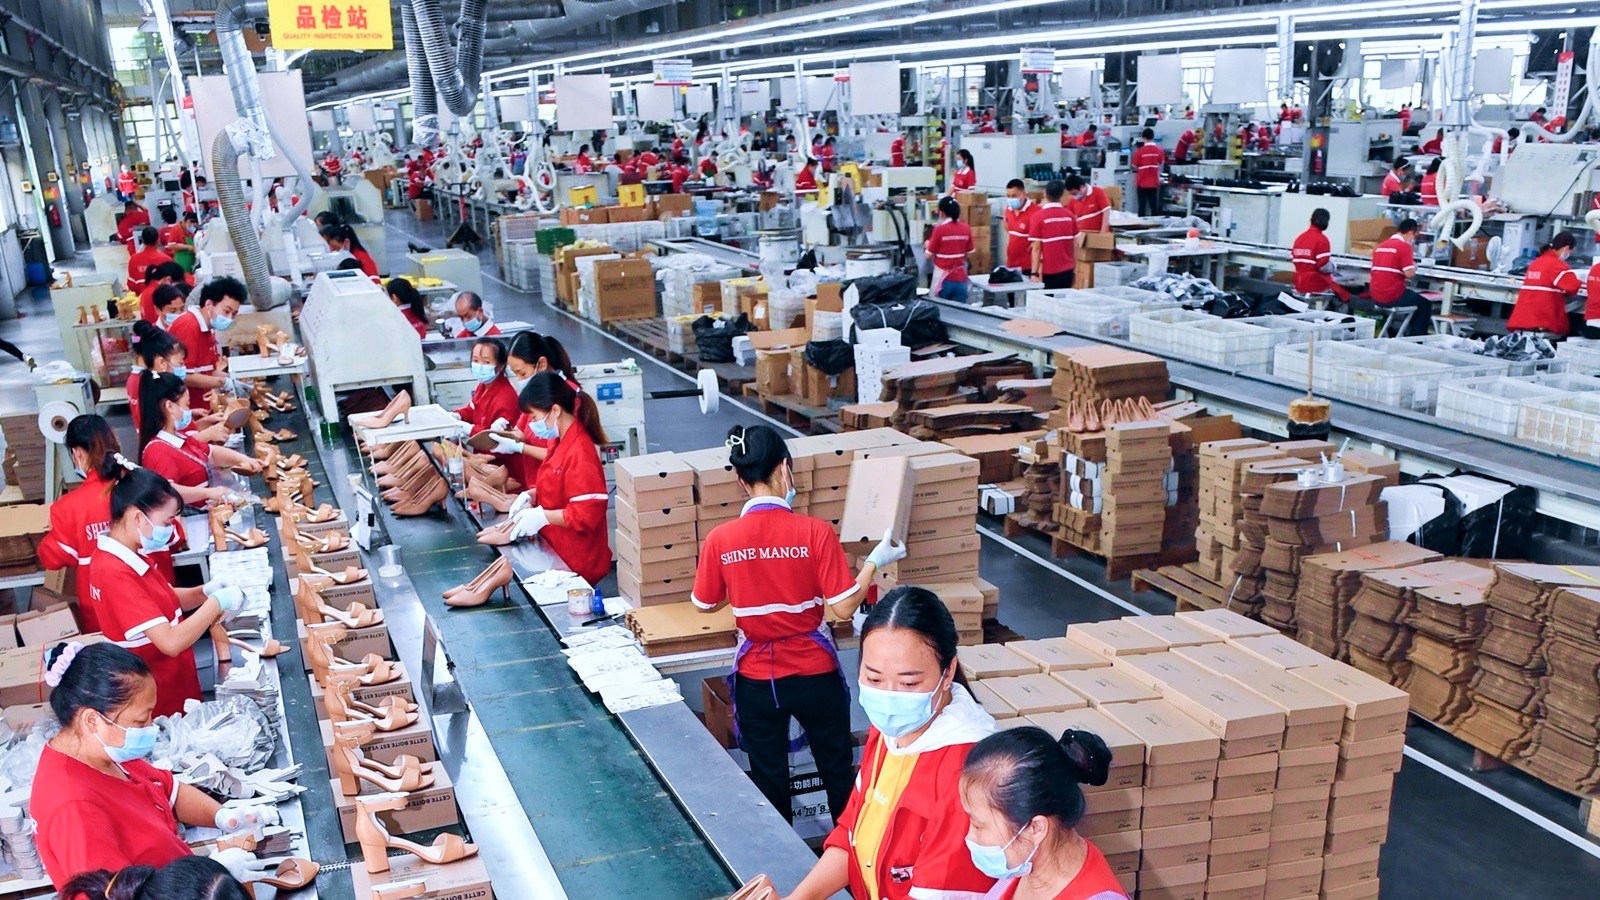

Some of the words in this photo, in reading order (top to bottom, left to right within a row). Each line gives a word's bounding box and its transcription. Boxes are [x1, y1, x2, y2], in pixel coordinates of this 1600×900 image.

[296, 5, 368, 29] 品检站
[85, 521, 110, 540] SHIN
[720, 548, 756, 565] SHINE
[759, 546, 809, 559] MANOR
[790, 777, 823, 790] 功能用
[463, 890, 486, 899] CETTE
